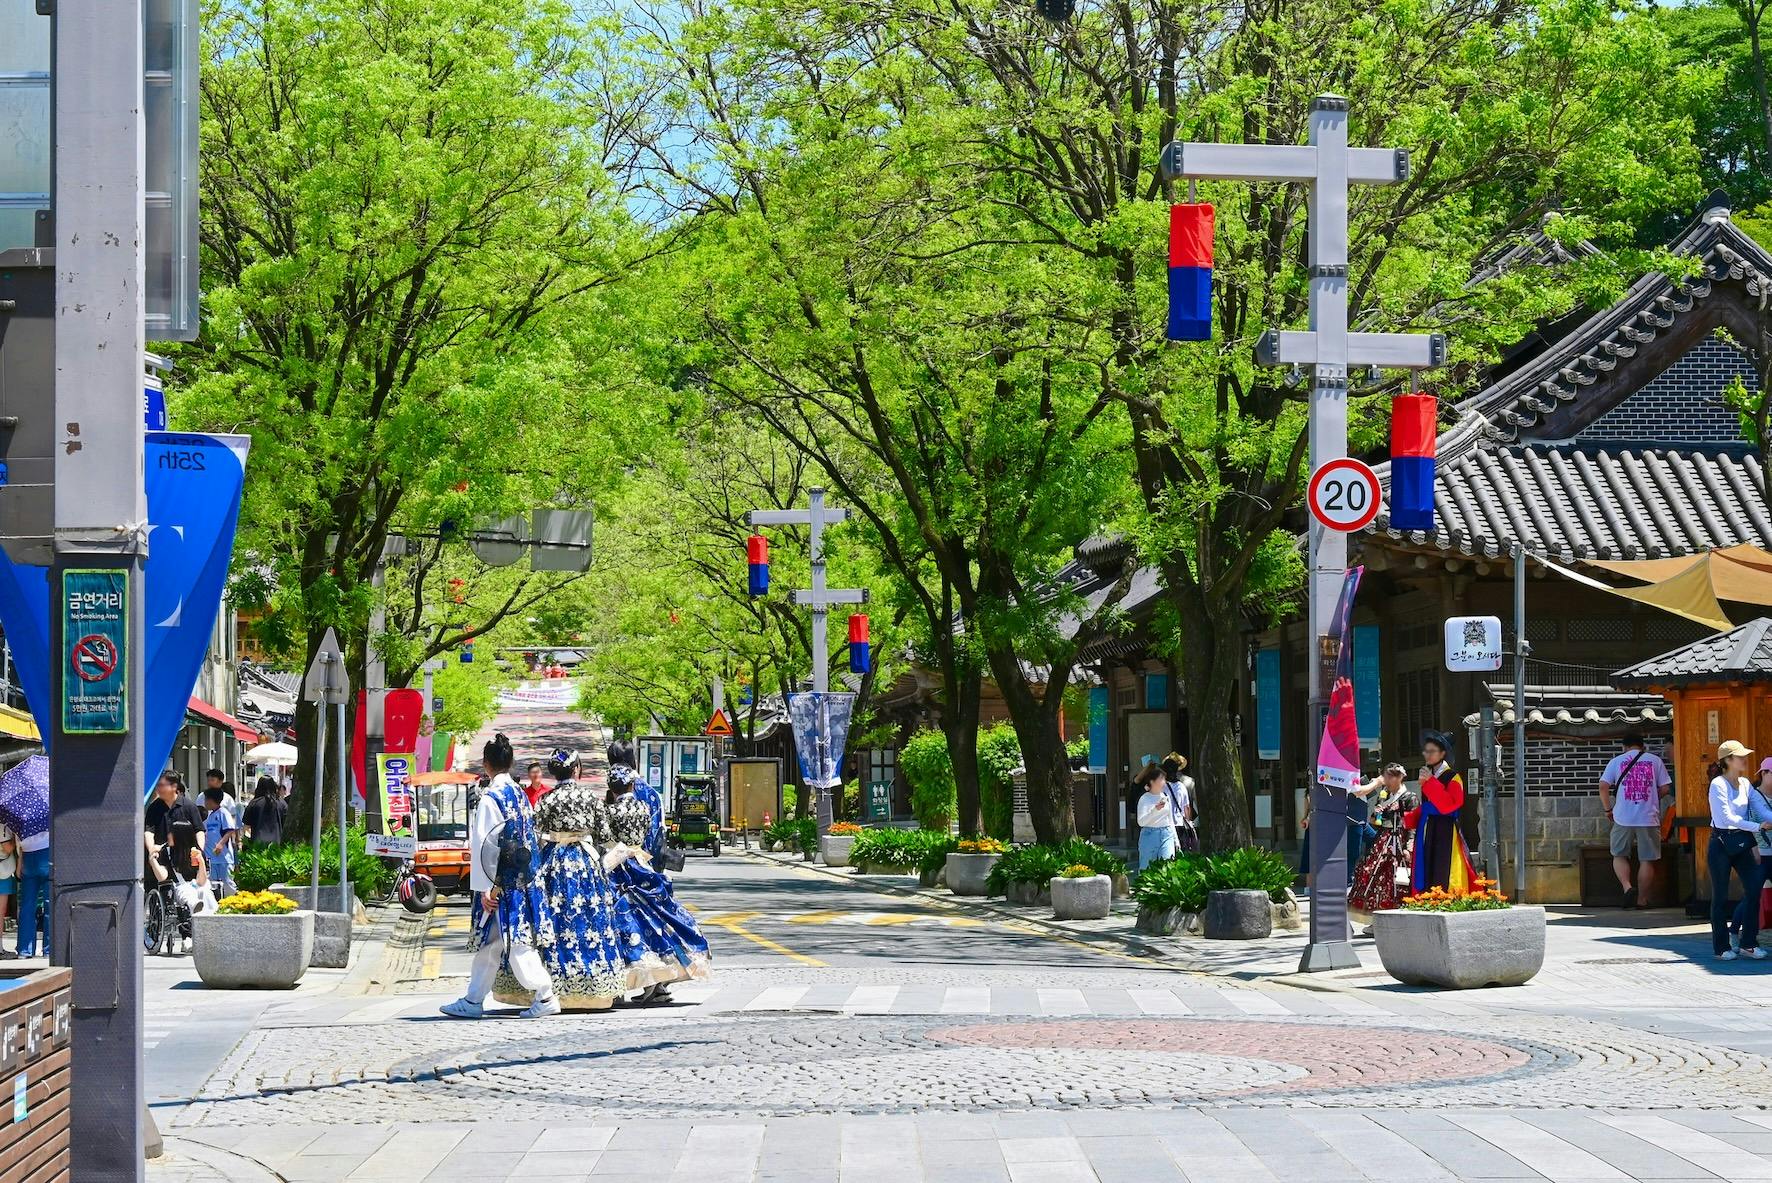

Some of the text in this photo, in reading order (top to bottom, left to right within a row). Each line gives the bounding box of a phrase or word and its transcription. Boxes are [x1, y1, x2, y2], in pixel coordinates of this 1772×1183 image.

[1324, 480, 1366, 511] 20
[69, 592, 122, 610] 금연거리
[80, 612, 105, 621] Smoking
[105, 612, 118, 620] Area
